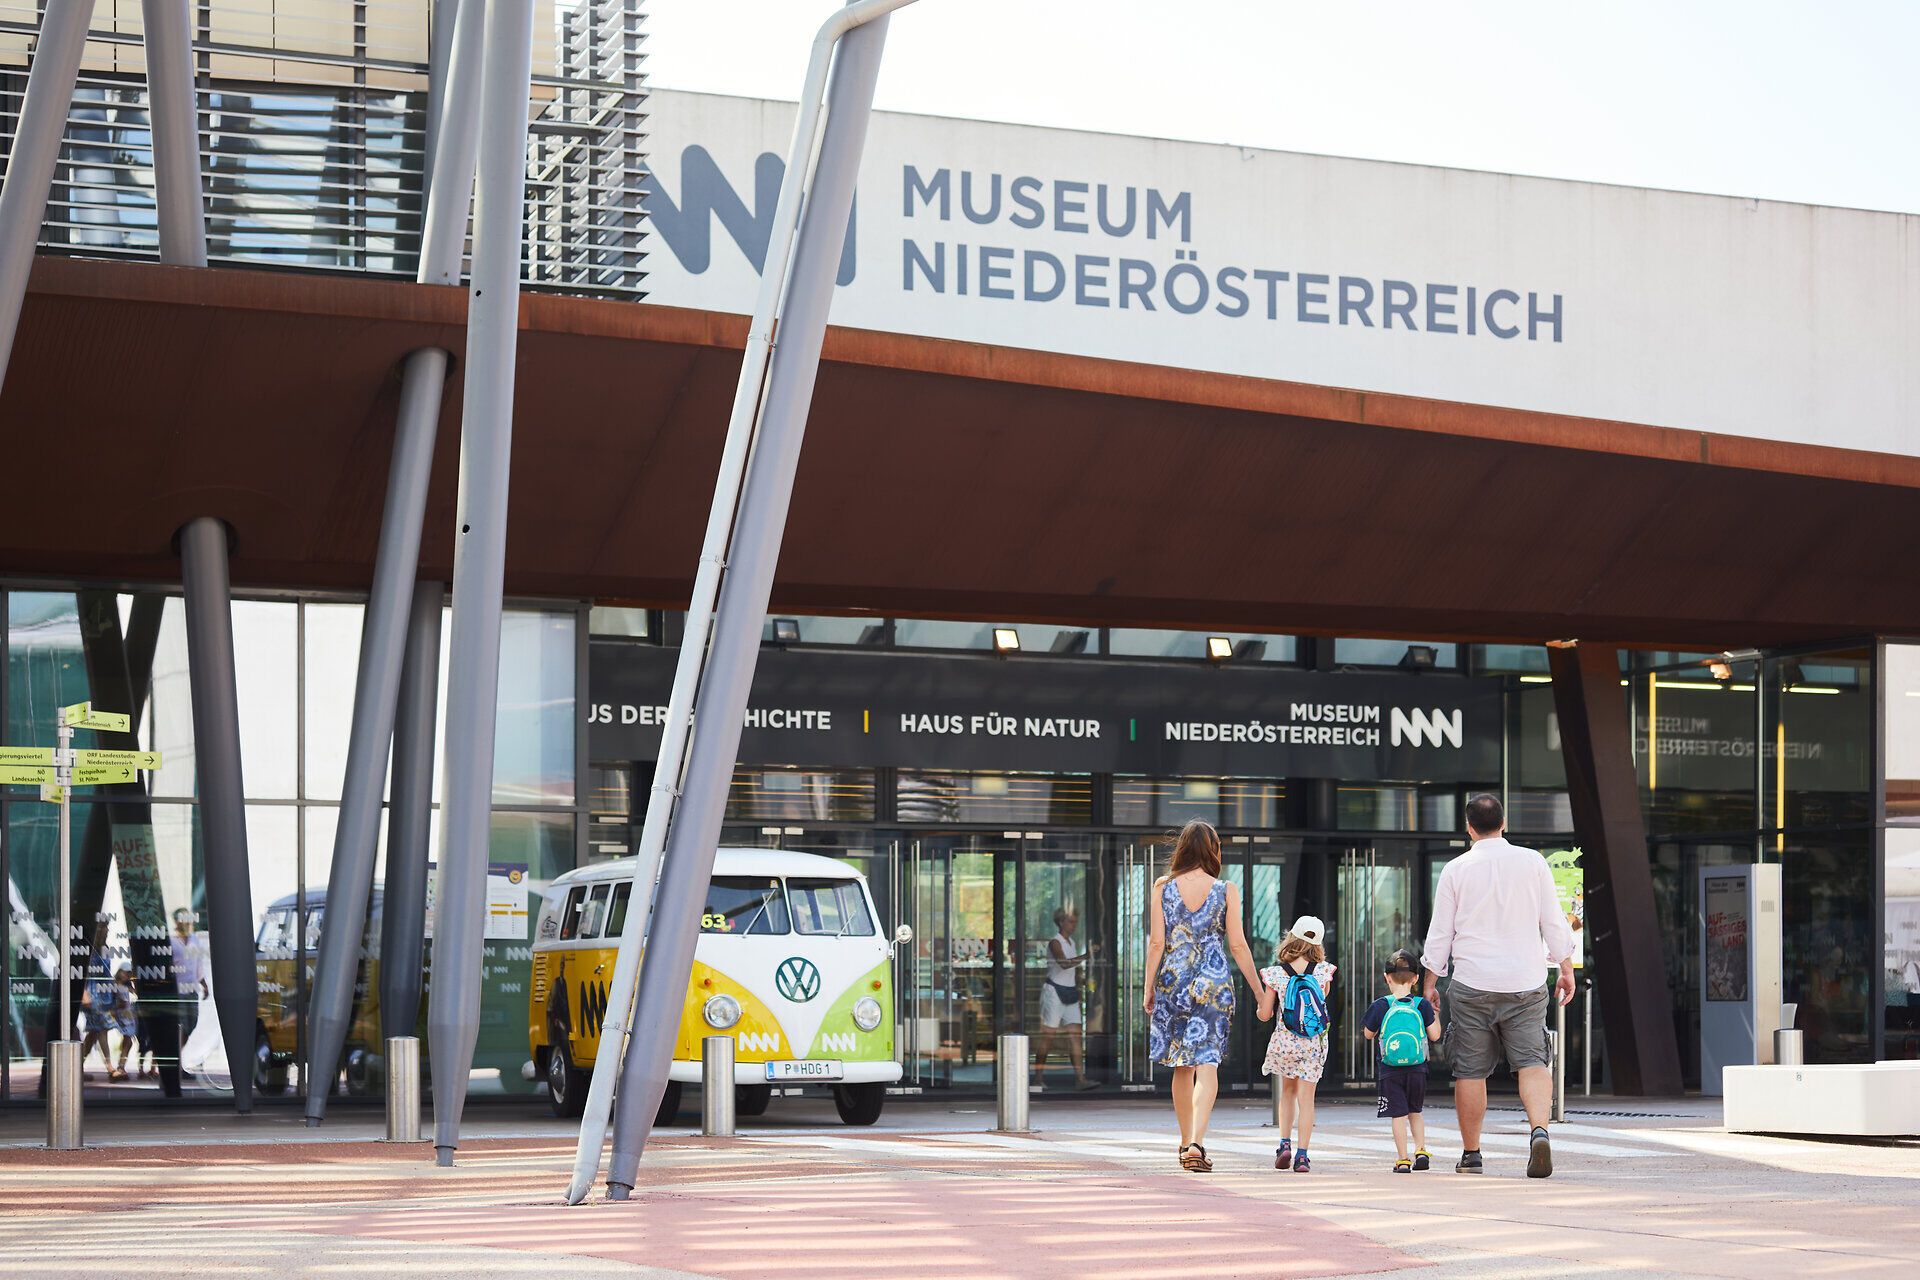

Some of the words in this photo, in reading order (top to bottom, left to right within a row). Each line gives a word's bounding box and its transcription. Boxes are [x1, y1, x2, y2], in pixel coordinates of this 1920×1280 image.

[903, 165, 1191, 242] MUSEUM
[903, 239, 1563, 343] NIEDERÖSTERREICH
[900, 714, 964, 735] HAUS
[970, 712, 1018, 736] FÜR
[1024, 717, 1101, 738] NATUR
[1290, 703, 1380, 723] MUSEUM
[1165, 720, 1380, 746] NIEDERÖSTERREICH
[784, 1063, 792, 1075] P
[800, 1063, 822, 1075] HDG
